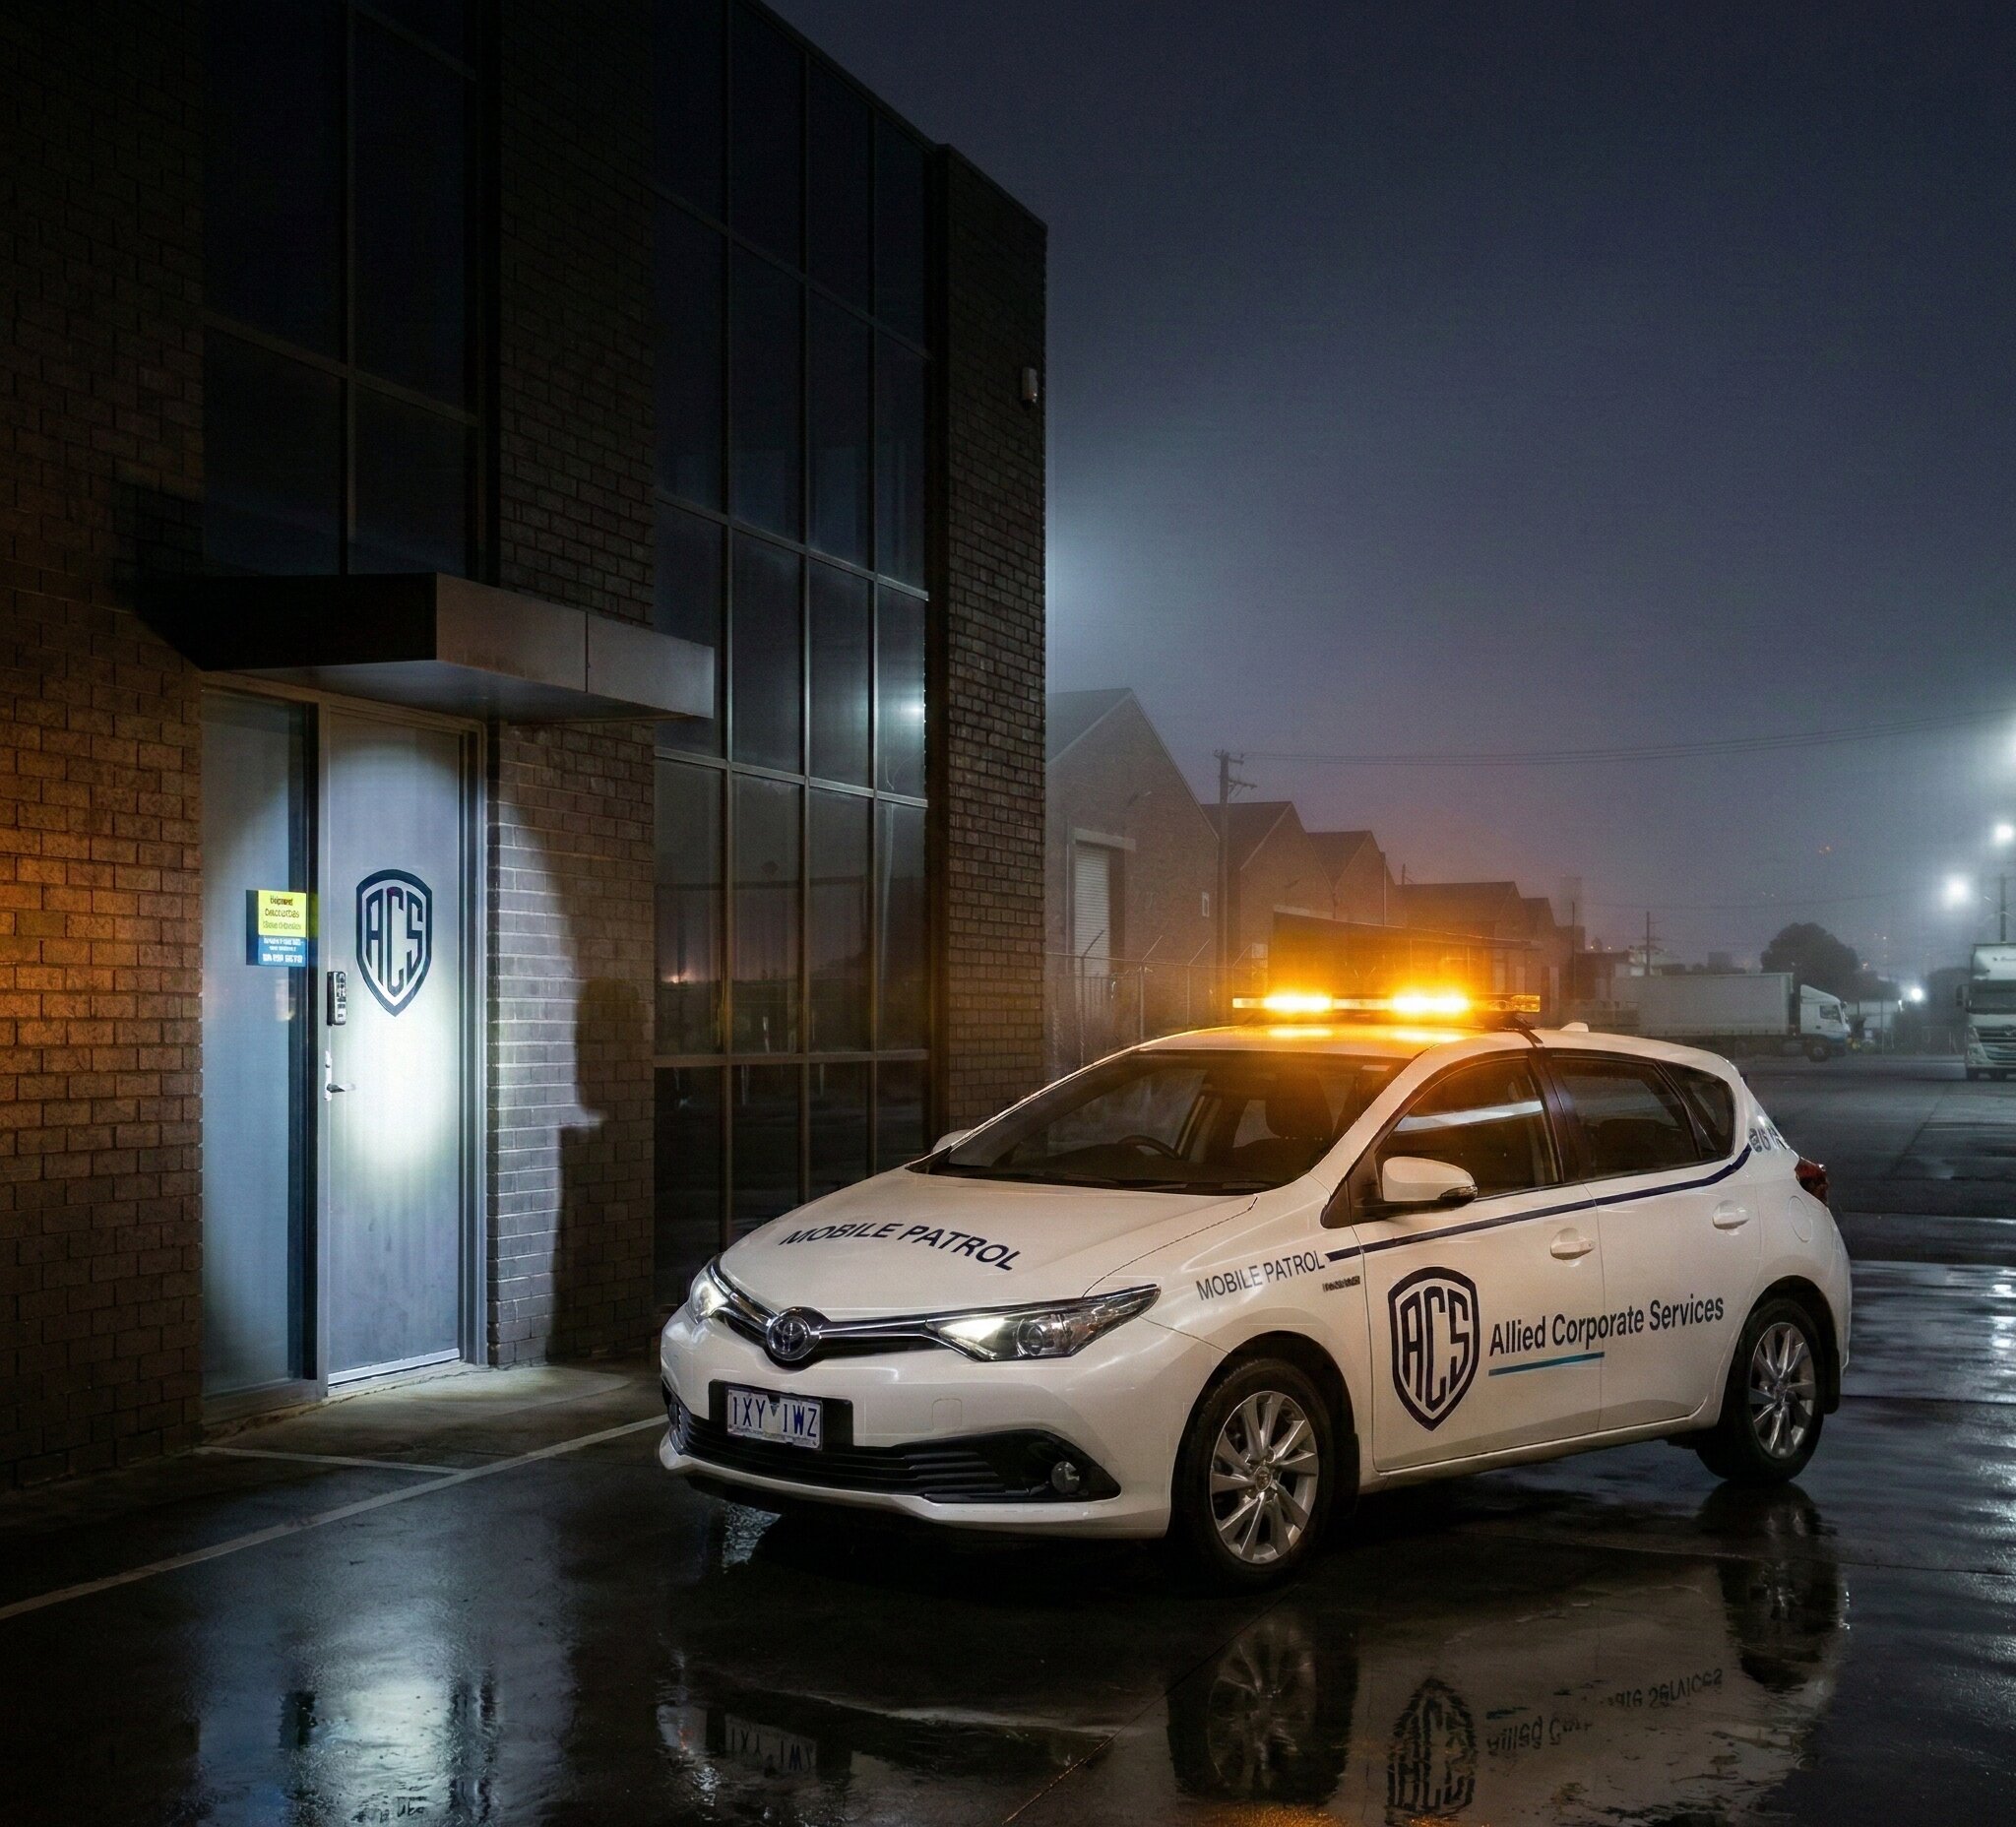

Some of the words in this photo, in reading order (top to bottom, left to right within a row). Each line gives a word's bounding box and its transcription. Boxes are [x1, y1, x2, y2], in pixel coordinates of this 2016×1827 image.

[364, 885, 424, 998] ACS
[778, 1223, 904, 1246] MOBILE
[897, 1225, 1021, 1271] PATROL
[1195, 1264, 1263, 1301] MOBILE
[1263, 1250, 1326, 1283] PATROL
[1399, 1286, 1471, 1413] ACS
[1488, 1315, 1546, 1357] Allied
[1551, 1304, 1645, 1350] Corporate
[1649, 1292, 1725, 1331] Services
